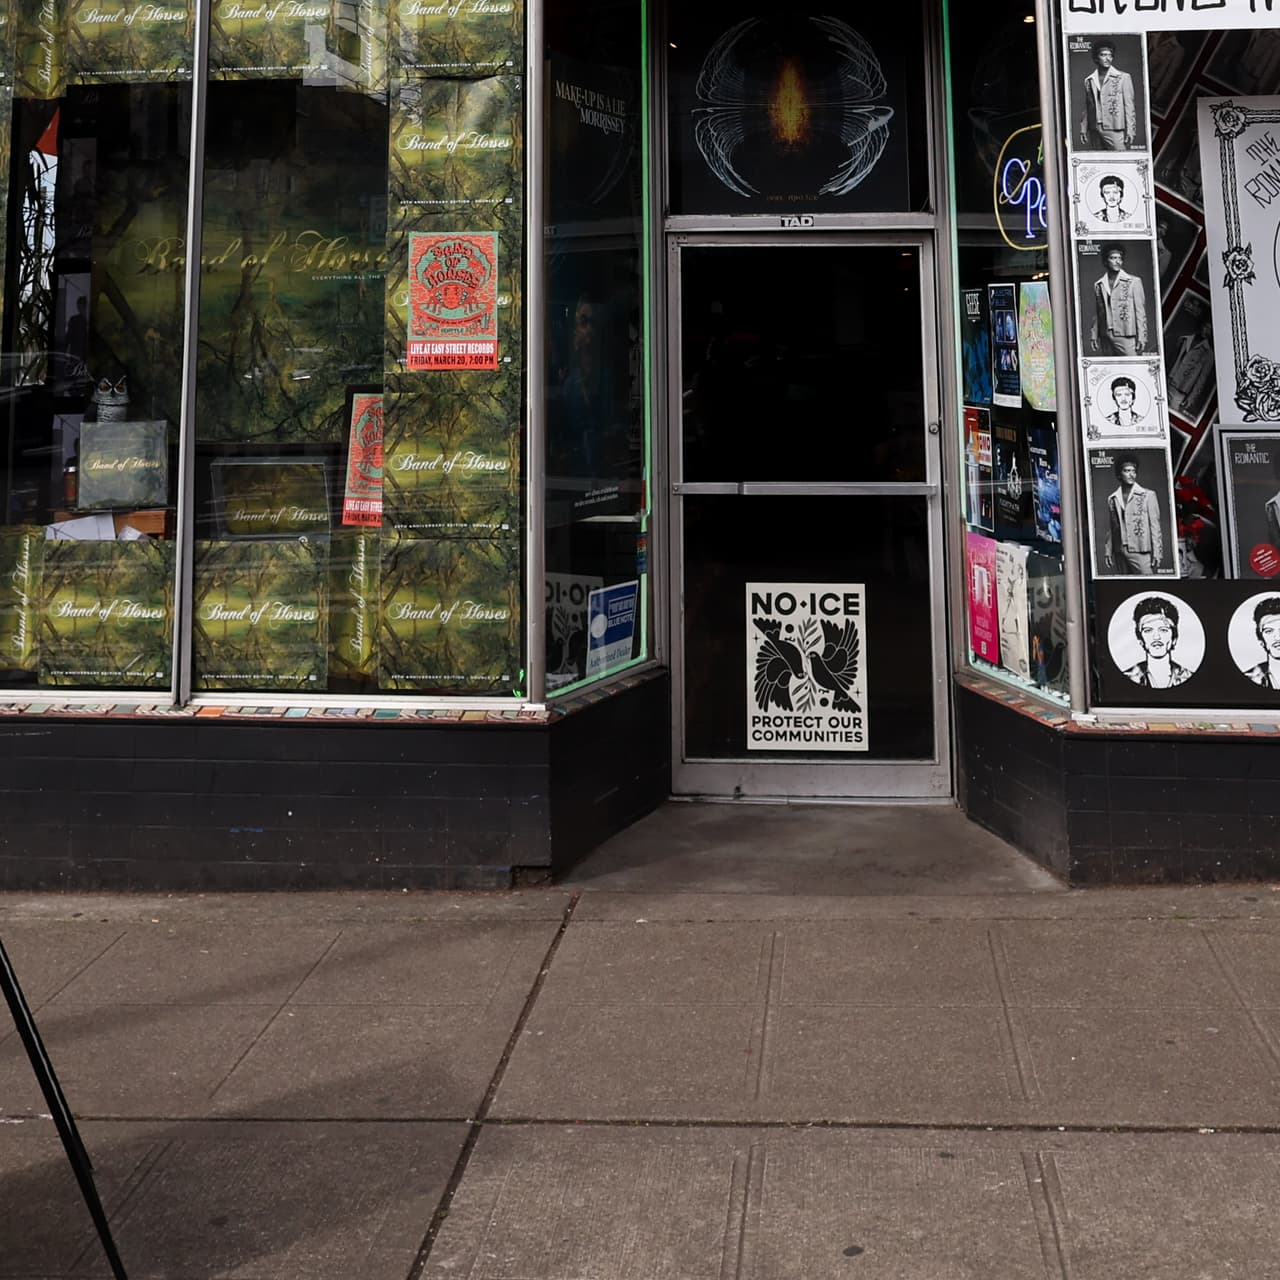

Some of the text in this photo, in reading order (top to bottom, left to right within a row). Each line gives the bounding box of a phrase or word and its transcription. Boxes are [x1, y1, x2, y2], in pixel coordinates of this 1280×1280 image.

[77, 4, 187, 30] Band of Horses
[220, 0, 331, 25] Band of Horses
[398, 0, 450, 17] Band
[397, 131, 514, 158] Band of Horses
[781, 216, 814, 228] TAD
[431, 342, 445, 355] EASY
[444, 342, 467, 355] STREET
[466, 342, 494, 354] RECORDS
[391, 451, 511, 479] Band of Horses
[1234, 453, 1270, 465] ROMANTIC
[49, 599, 167, 628] Band of Horses
[200, 601, 320, 631] Band of Horses
[388, 600, 510, 630] Band of Horses
[751, 591, 861, 616] NO ICE
[751, 715, 863, 729] PROTECT OUR
[751, 729, 864, 743] COMMUNITIES
